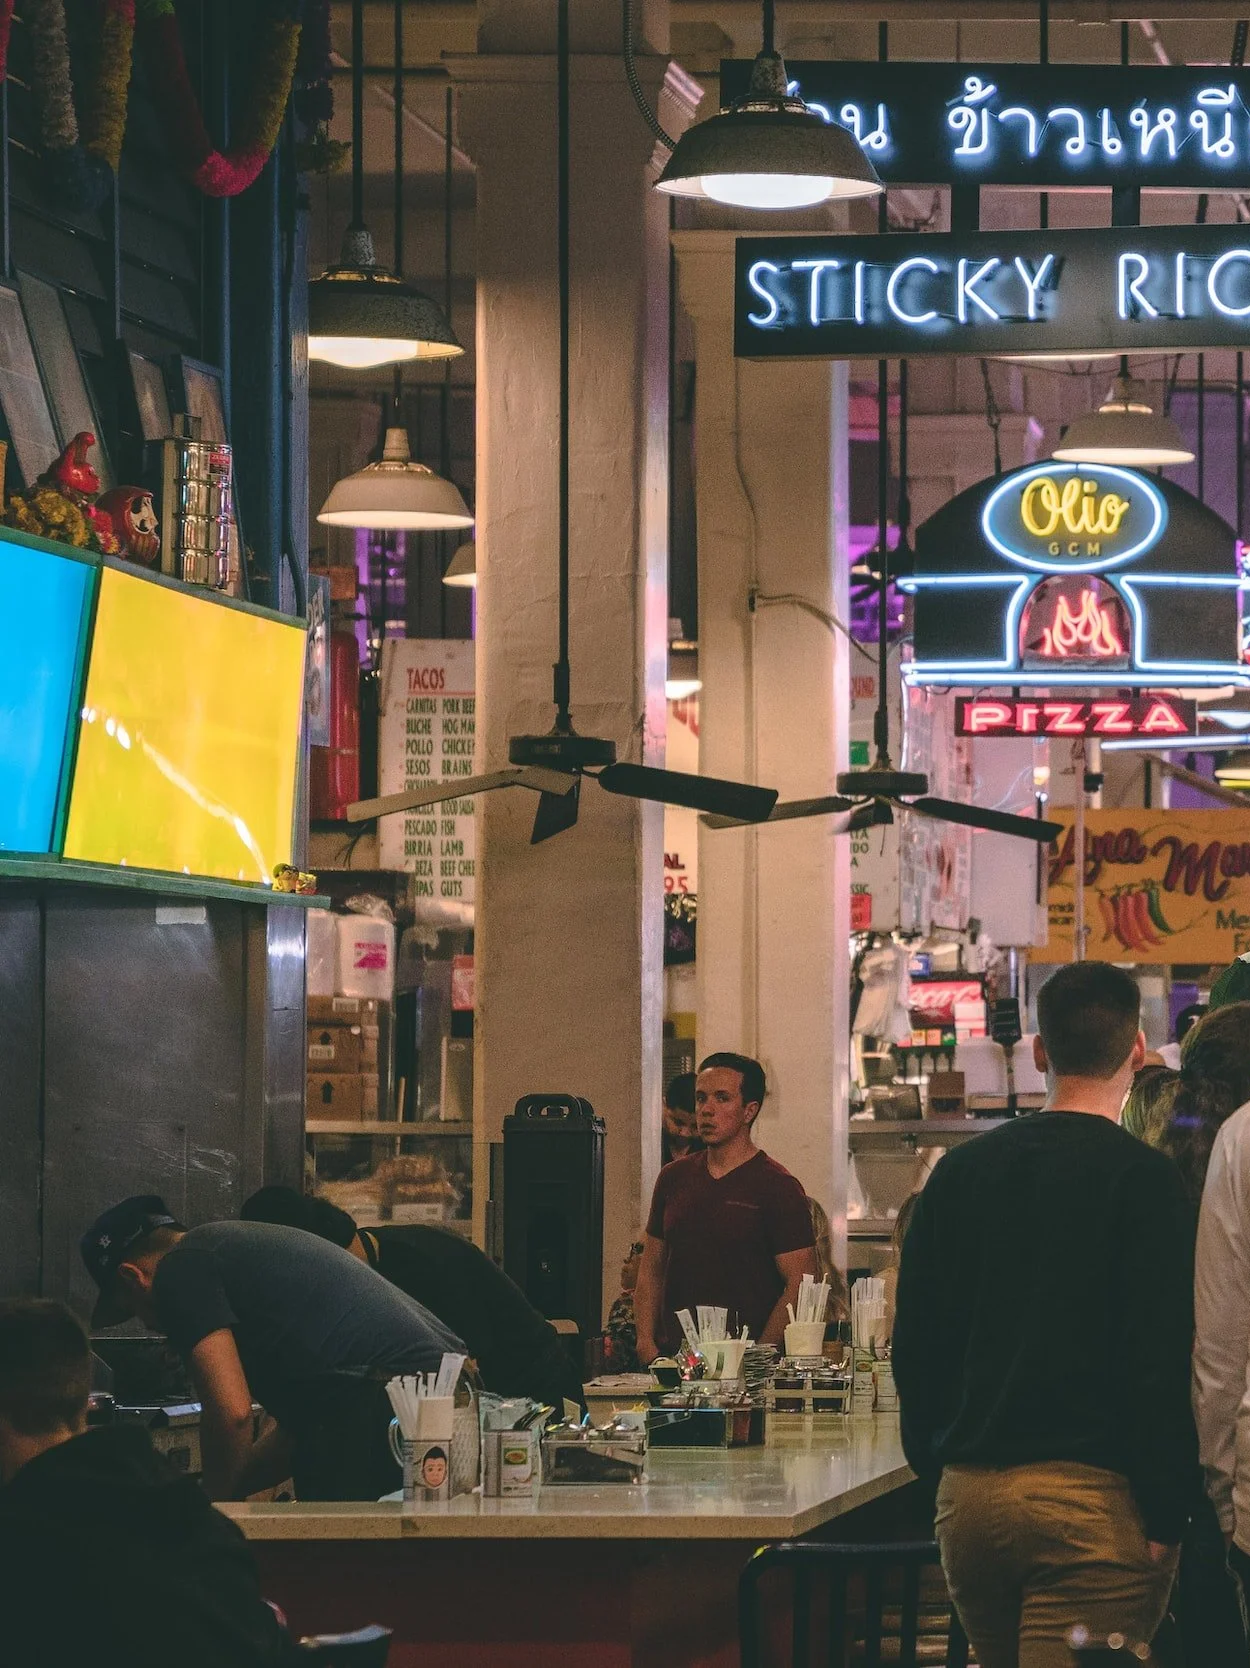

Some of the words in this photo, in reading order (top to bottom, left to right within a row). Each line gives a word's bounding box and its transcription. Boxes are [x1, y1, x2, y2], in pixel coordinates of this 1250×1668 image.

[747, 254, 1054, 326] STICKY
[1021, 477, 1130, 536] Olio
[407, 668, 445, 689] TACOS
[406, 698, 436, 713] CARNITAS
[443, 698, 459, 713] PORK
[964, 702, 1188, 732] PIZZA
[406, 719, 431, 734] BUCHE
[442, 719, 458, 734] HOG
[405, 739, 433, 755] POLLO
[406, 759, 430, 775] SESOS
[442, 759, 472, 775] BRAINS
[404, 820, 437, 836] PESCADO
[440, 820, 455, 836] FISH
[404, 840, 433, 856] BIRRIA
[440, 840, 464, 856] LAMB
[440, 860, 455, 876] BEEF
[440, 880, 463, 897] GUTS
